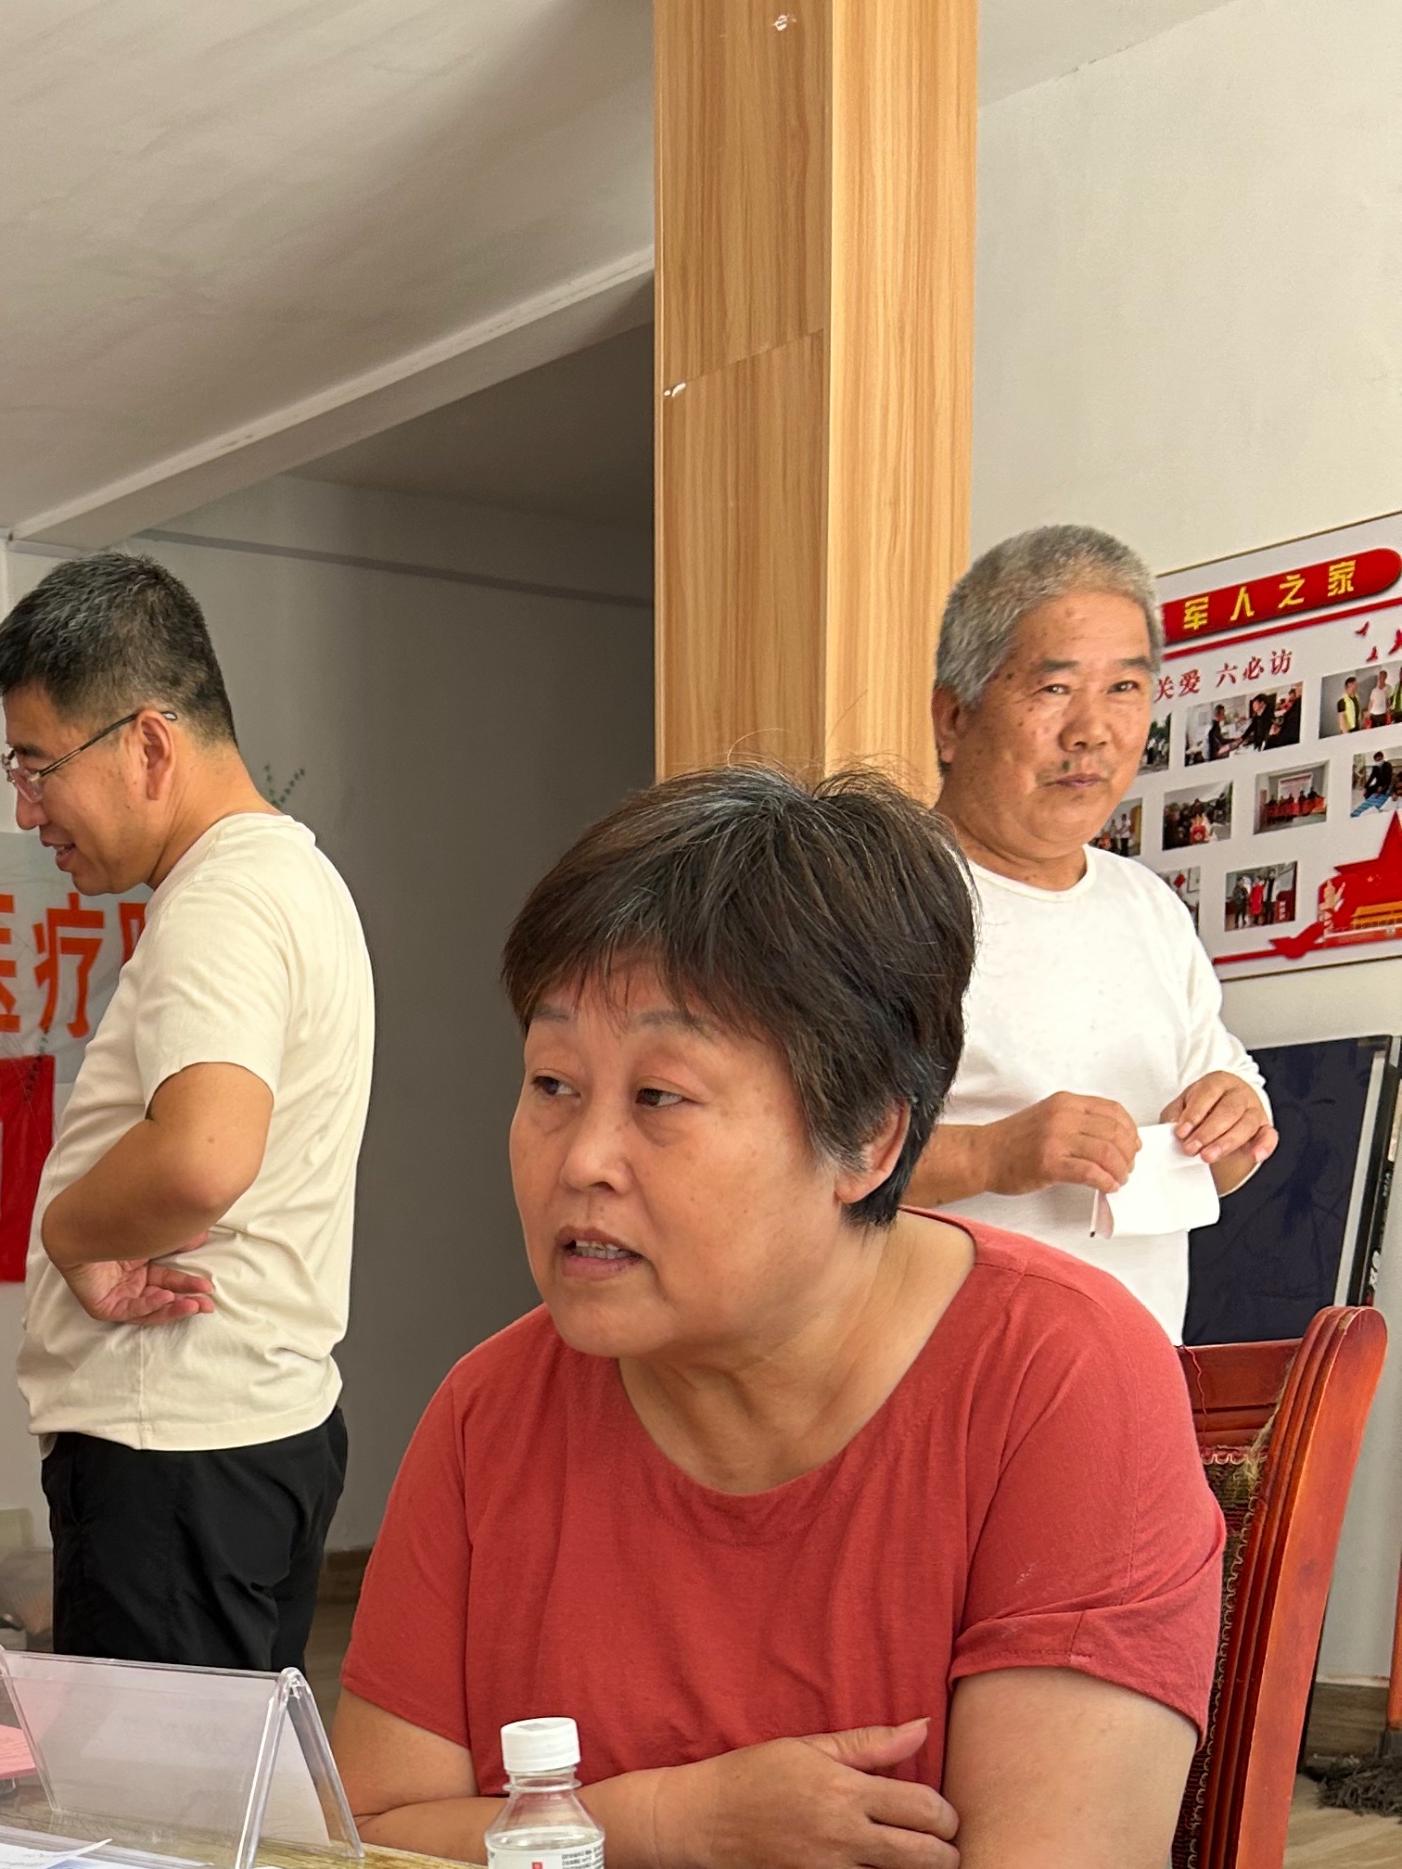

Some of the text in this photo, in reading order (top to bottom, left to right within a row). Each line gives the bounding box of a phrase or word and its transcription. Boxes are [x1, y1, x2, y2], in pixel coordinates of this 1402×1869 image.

[1183, 559, 1356, 631] 军人之家
[1216, 648, 1293, 689] 六必访
